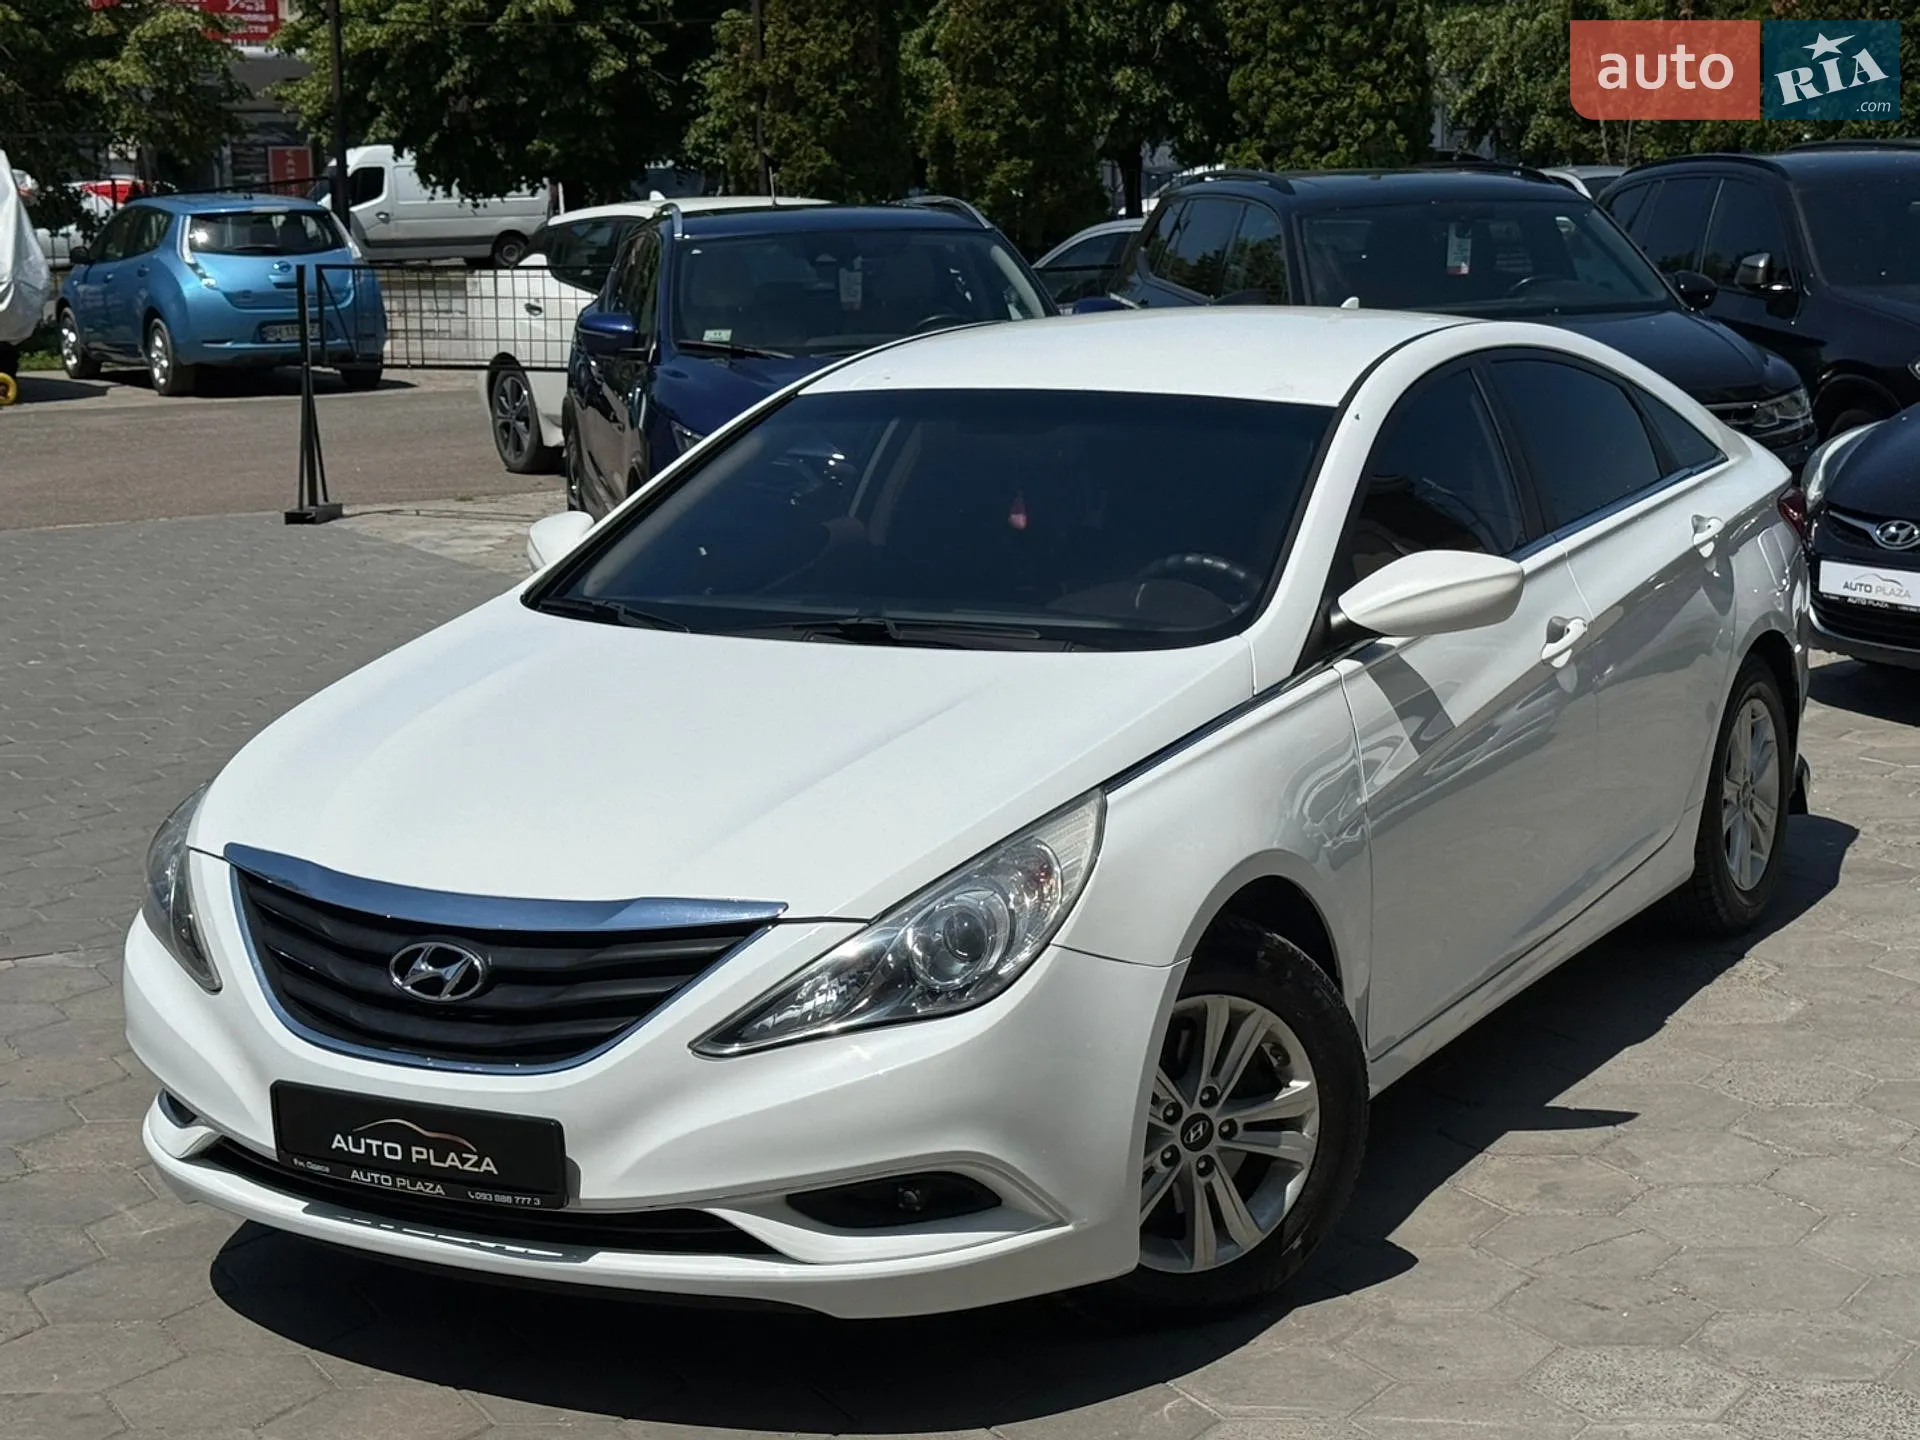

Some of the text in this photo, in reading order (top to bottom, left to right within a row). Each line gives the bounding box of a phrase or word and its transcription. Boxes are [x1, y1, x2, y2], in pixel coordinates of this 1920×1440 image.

[1843, 581, 1911, 600] AUTO PLAZA
[331, 1134, 499, 1175] AUTO PLAZA
[350, 1170, 446, 1196] AUTO PLAZA
